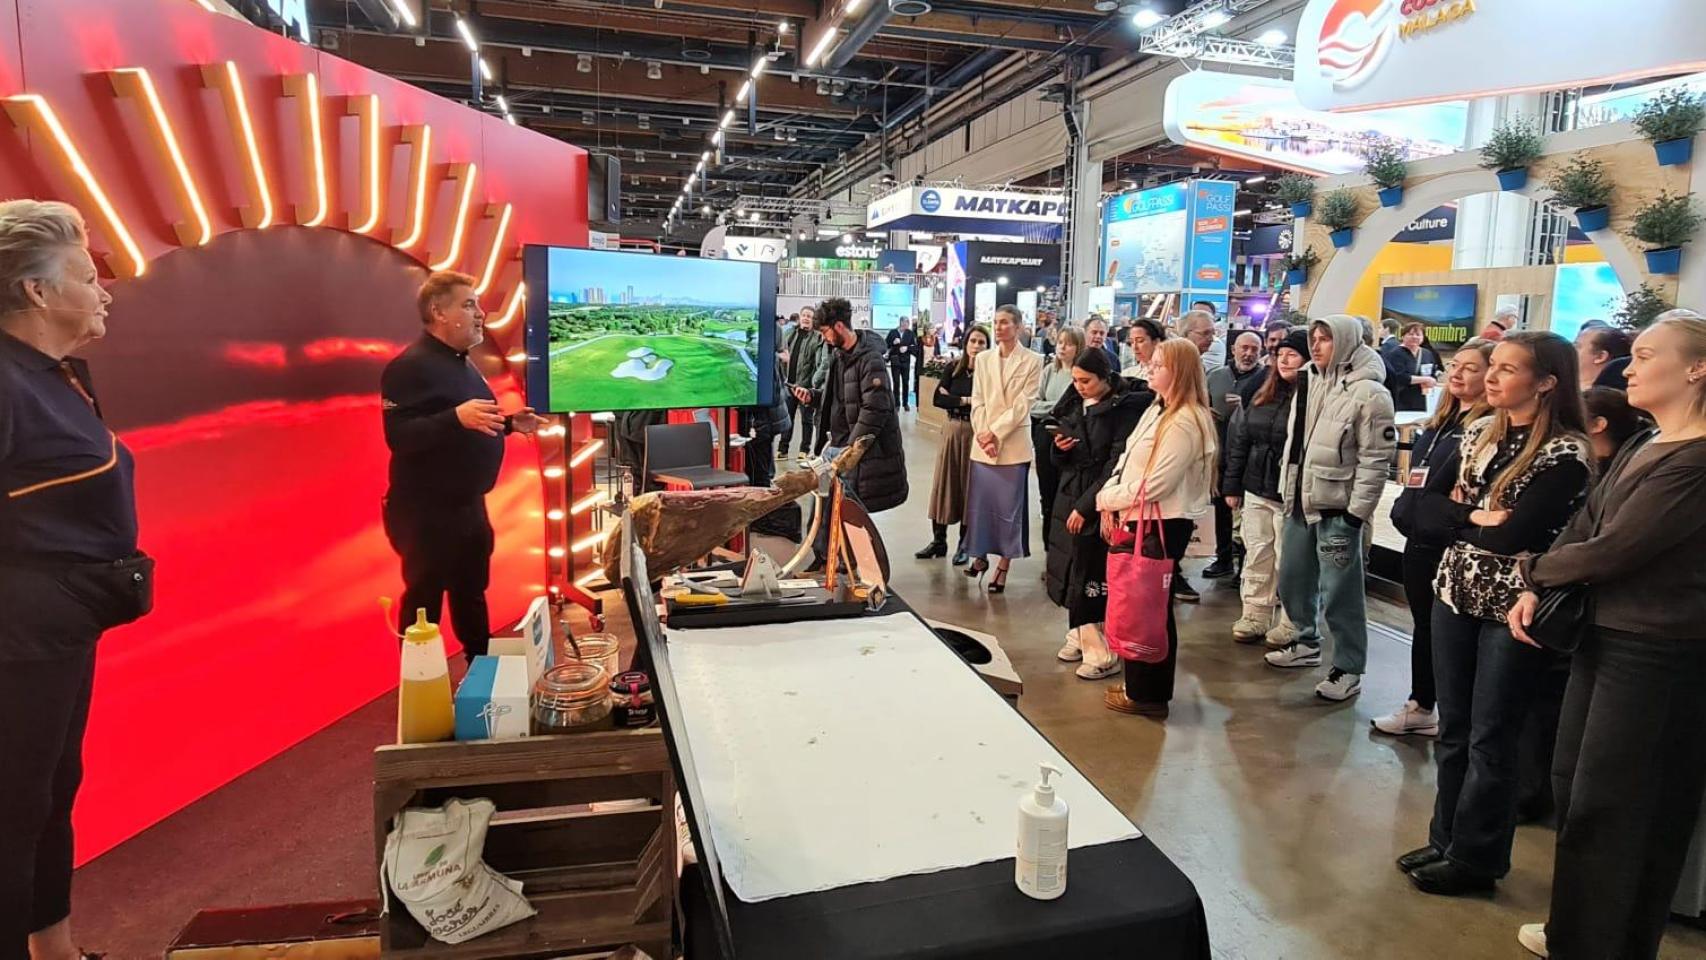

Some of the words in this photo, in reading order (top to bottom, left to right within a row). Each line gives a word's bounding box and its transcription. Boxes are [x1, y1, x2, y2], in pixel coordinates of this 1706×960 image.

[954, 195, 1066, 217] MATKAPO
[1408, 218, 1448, 231] Culture
[835, 241, 879, 258] estoni
[1426, 324, 1467, 341] nombre
